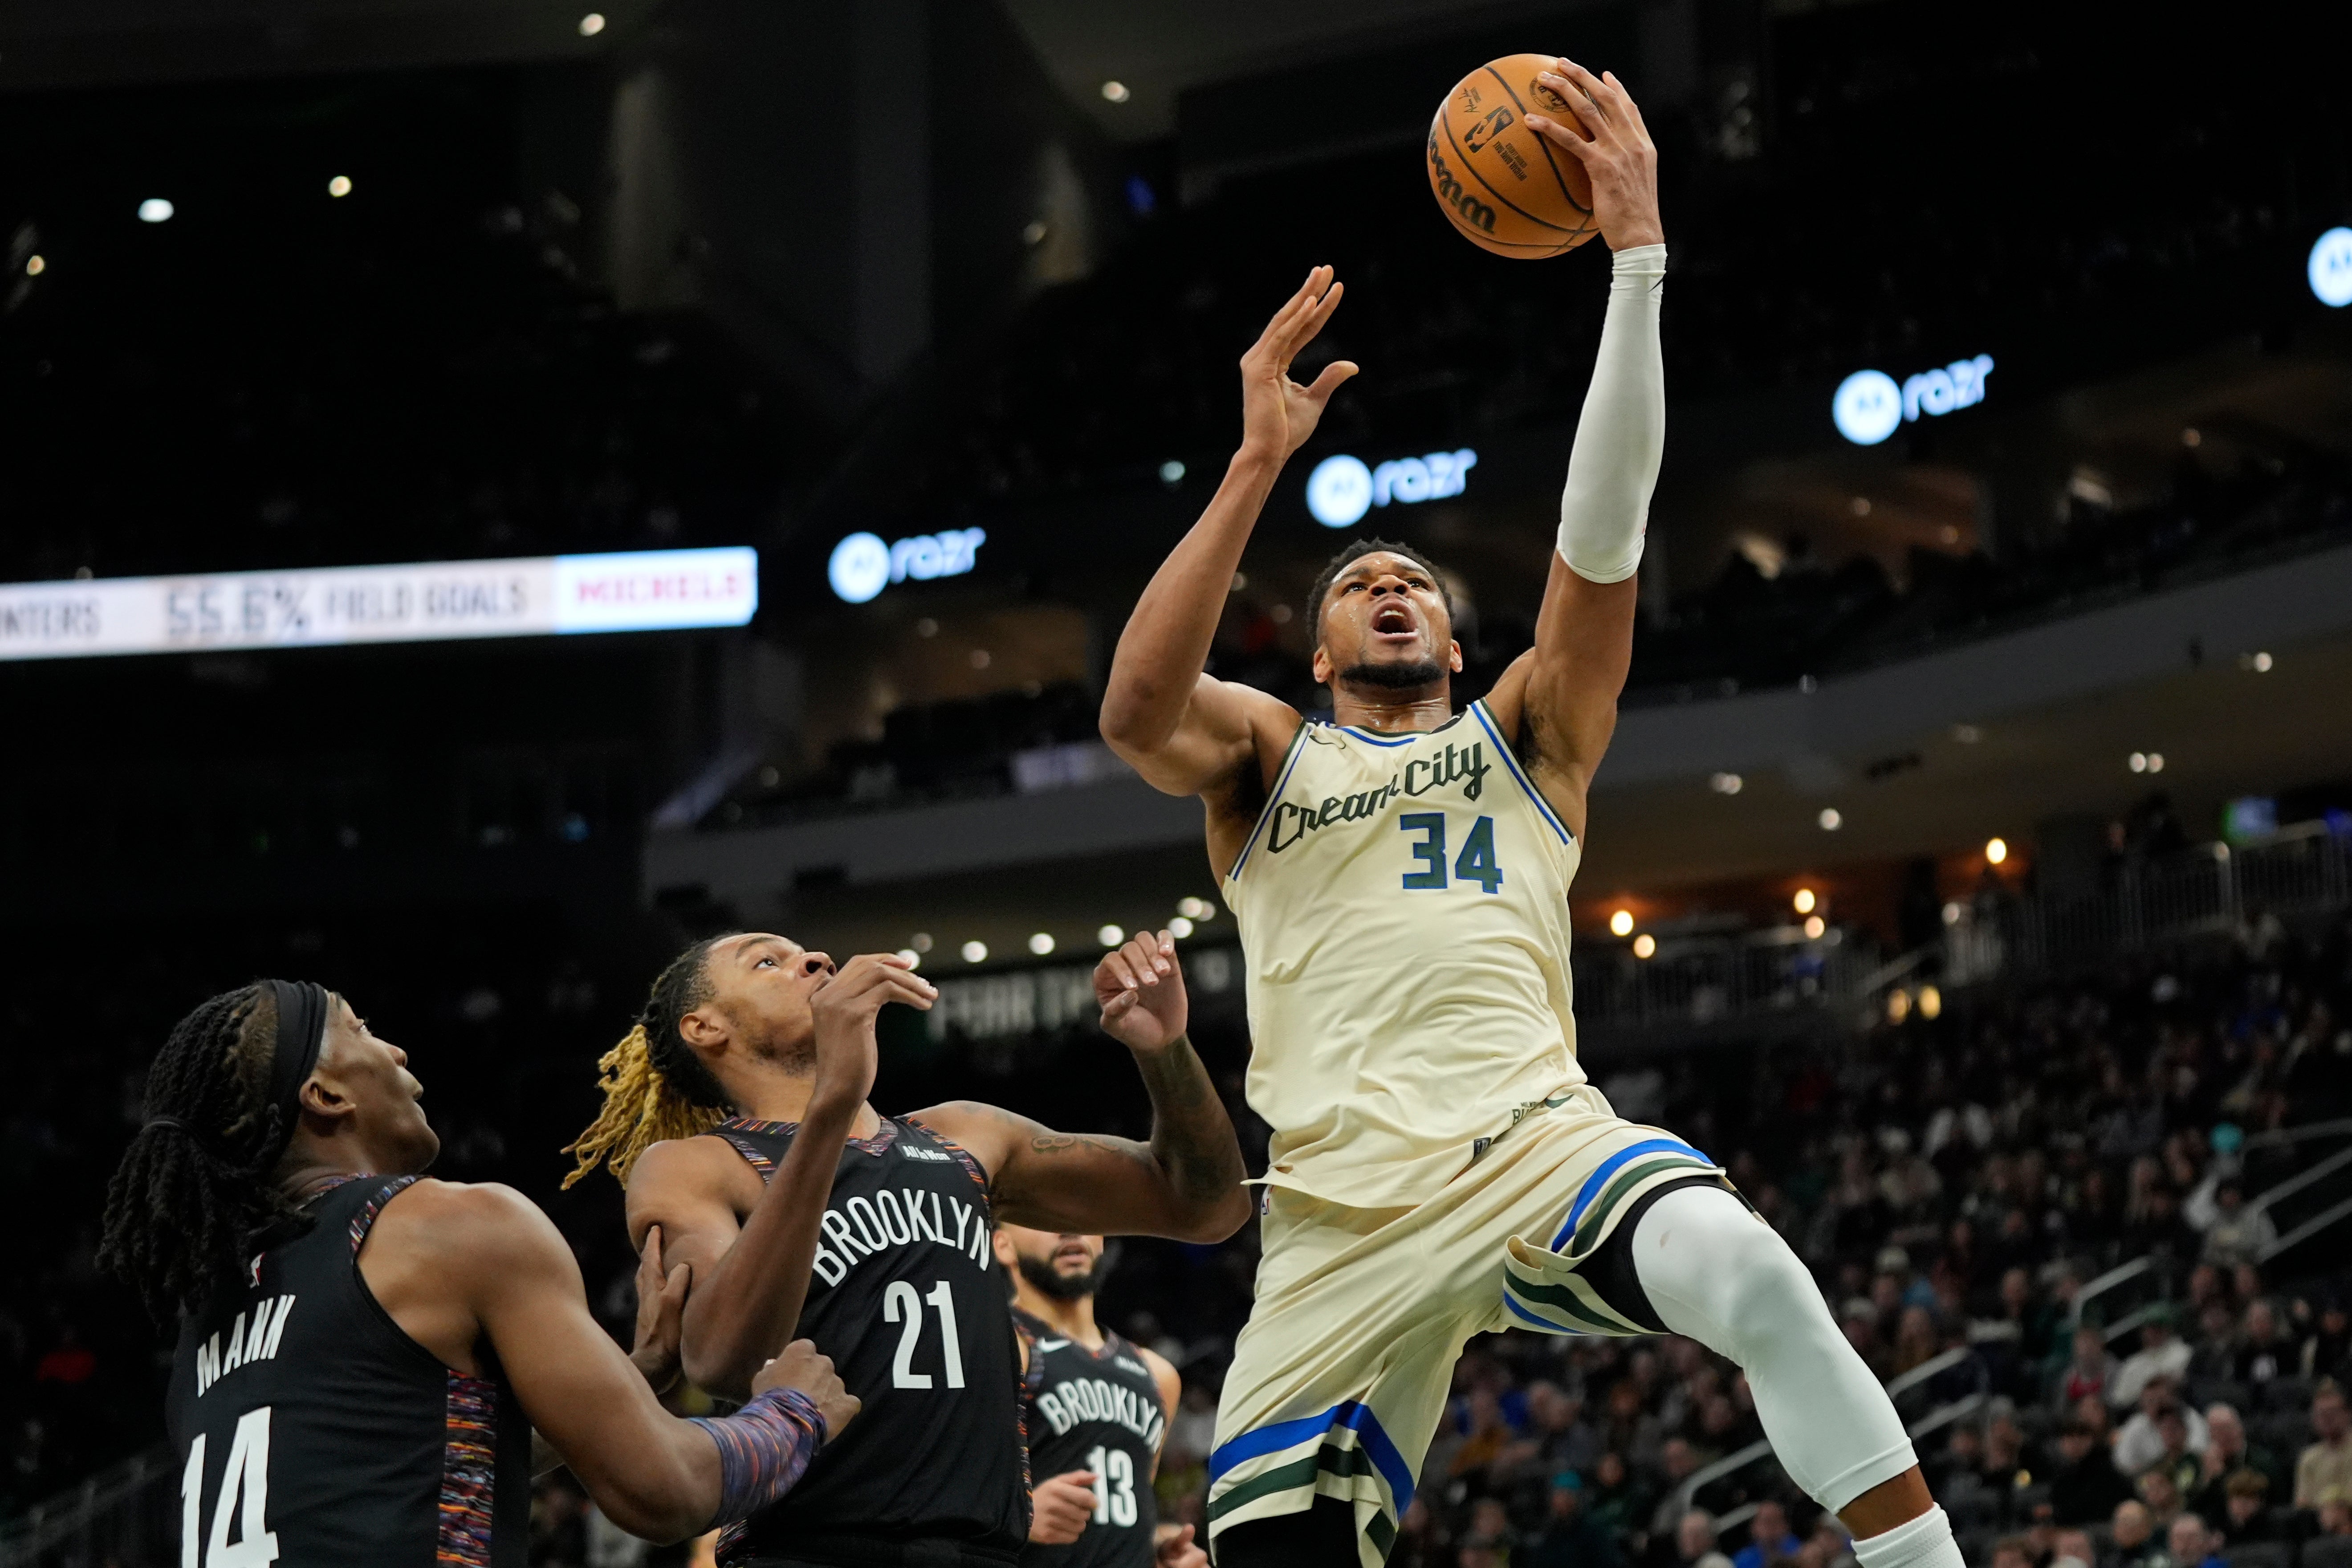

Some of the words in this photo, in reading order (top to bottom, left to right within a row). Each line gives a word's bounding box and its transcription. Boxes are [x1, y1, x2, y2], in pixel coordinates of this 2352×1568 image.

[1429, 130, 1497, 235] Wilson
[1903, 355, 1994, 421] razr
[1374, 448, 1477, 506] razr
[890, 528, 986, 582] razr
[167, 578, 311, 635] 55.6%
[325, 581, 414, 622] FIELD
[424, 574, 529, 617] GOALS
[1267, 774, 1401, 854] Cream
[1405, 742, 1491, 802] City
[1400, 812, 1503, 894] 34
[813, 1188, 990, 1287] BROOKLYN
[197, 1295, 296, 1397] MANN
[884, 1281, 965, 1389] 21
[1036, 1378, 1164, 1454] BROOKLYN
[181, 1406, 279, 1568] 14
[1086, 1445, 1137, 1527] 13
